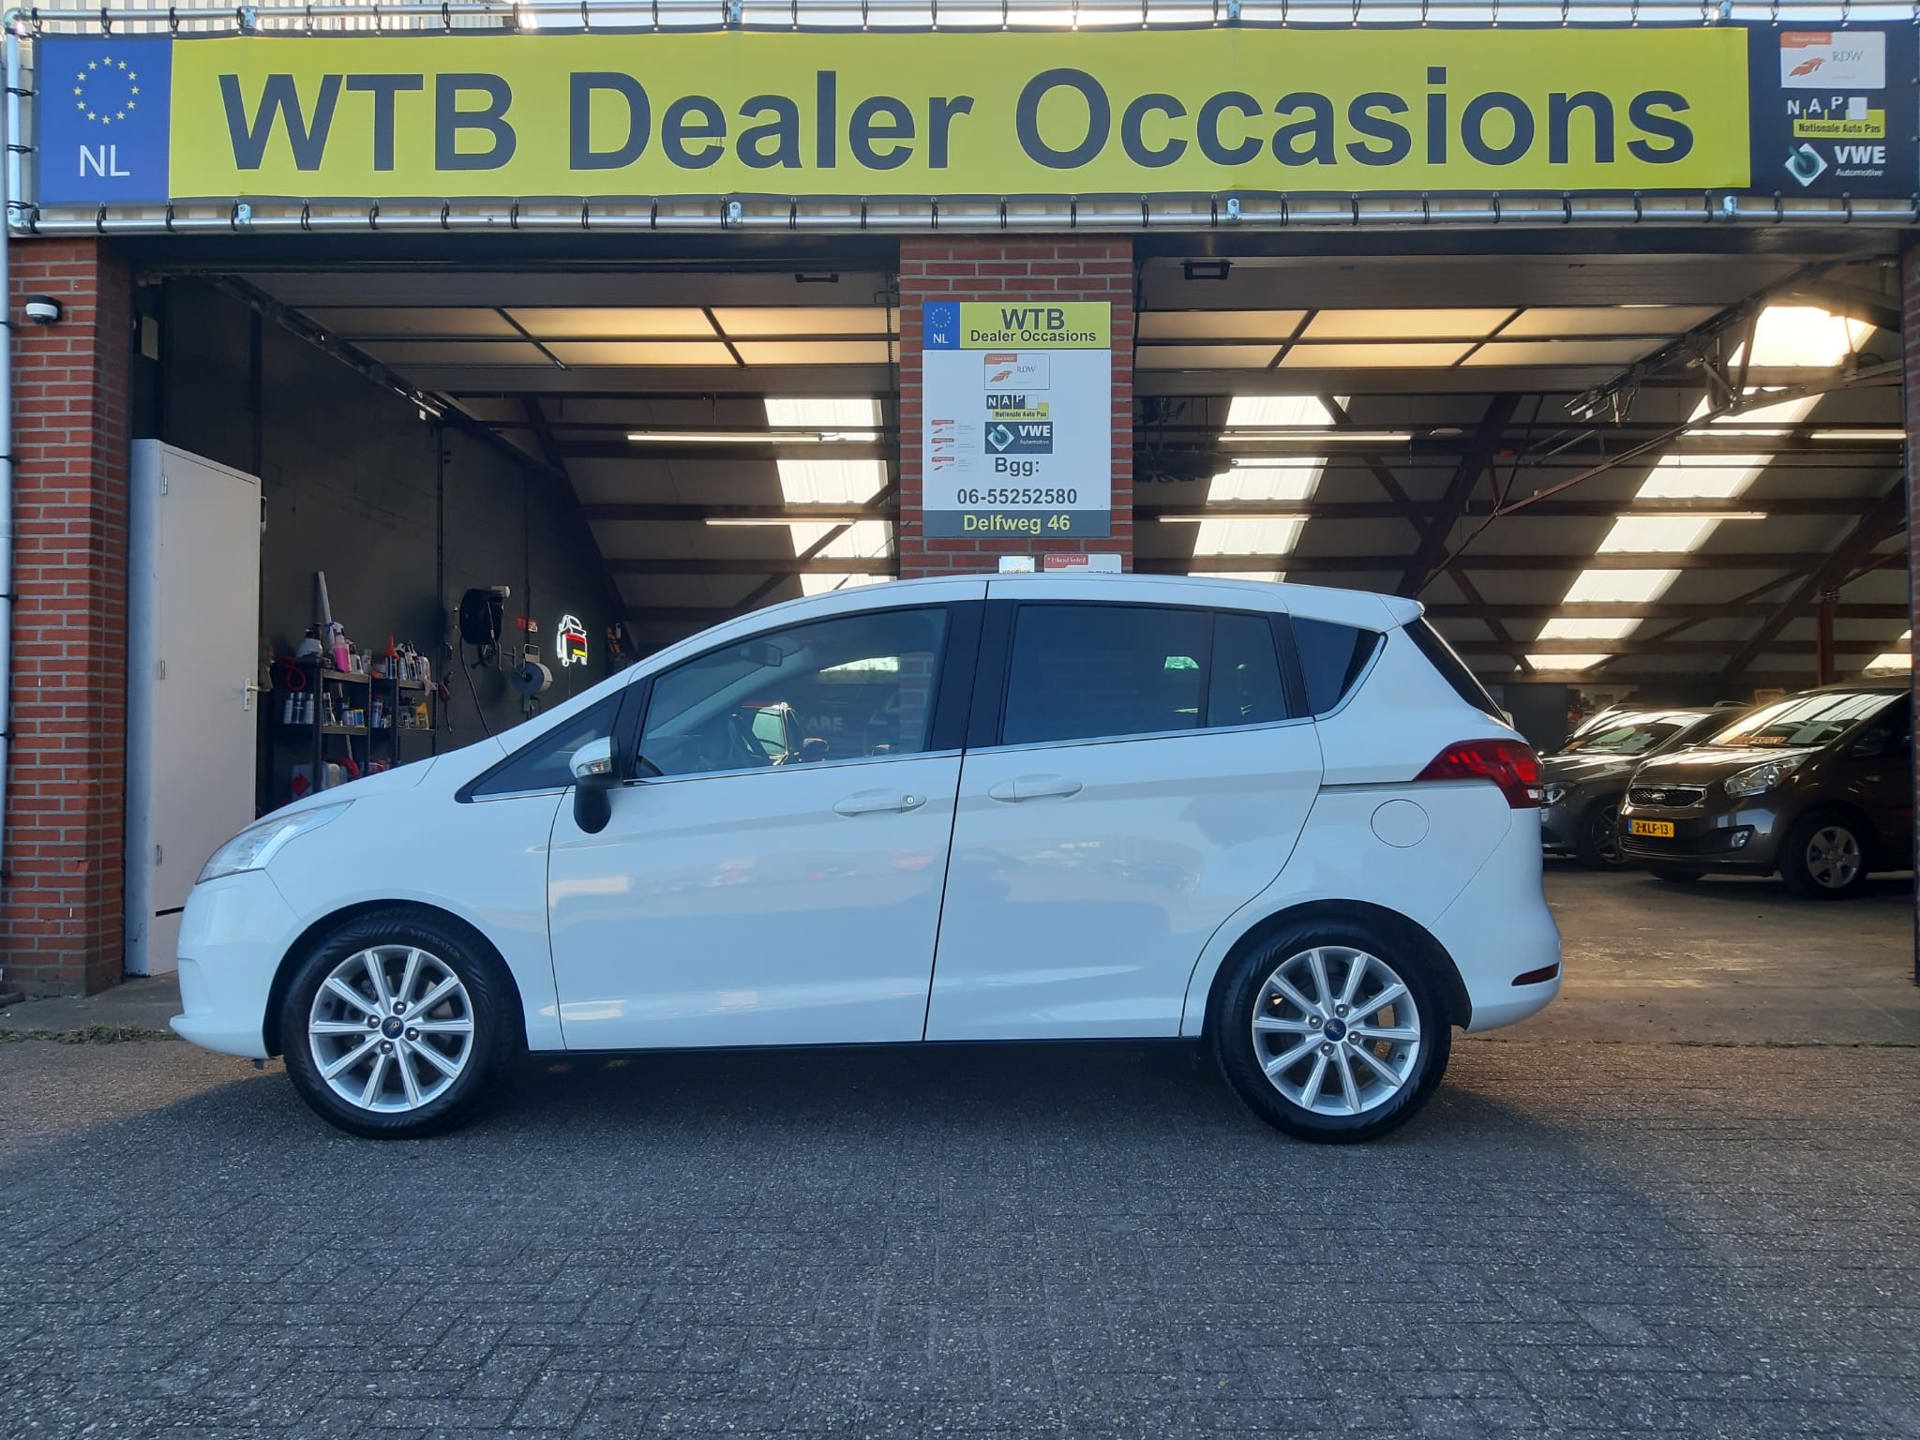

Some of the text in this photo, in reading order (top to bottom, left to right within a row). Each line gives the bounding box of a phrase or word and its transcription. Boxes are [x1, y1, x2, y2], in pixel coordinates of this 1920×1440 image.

[1832, 50, 1863, 62] RDW
[218, 65, 1694, 172] WTB Dealer Occasions
[1799, 123, 1880, 133] Nationale Auto Pas
[79, 144, 130, 178] NL
[1834, 145, 1886, 164] VWE
[1835, 168, 1883, 177] Automotive
[1001, 308, 1065, 330] WTB
[933, 334, 949, 344] NL
[970, 330, 1097, 342] Dealer Occasions
[1018, 425, 1051, 437] VWE
[995, 457, 1040, 477] Bgg:
[957, 488, 1078, 504] 06-55252580
[963, 514, 1071, 534] Delfweg 46
[1635, 822, 1669, 834] 2-KLF-13
